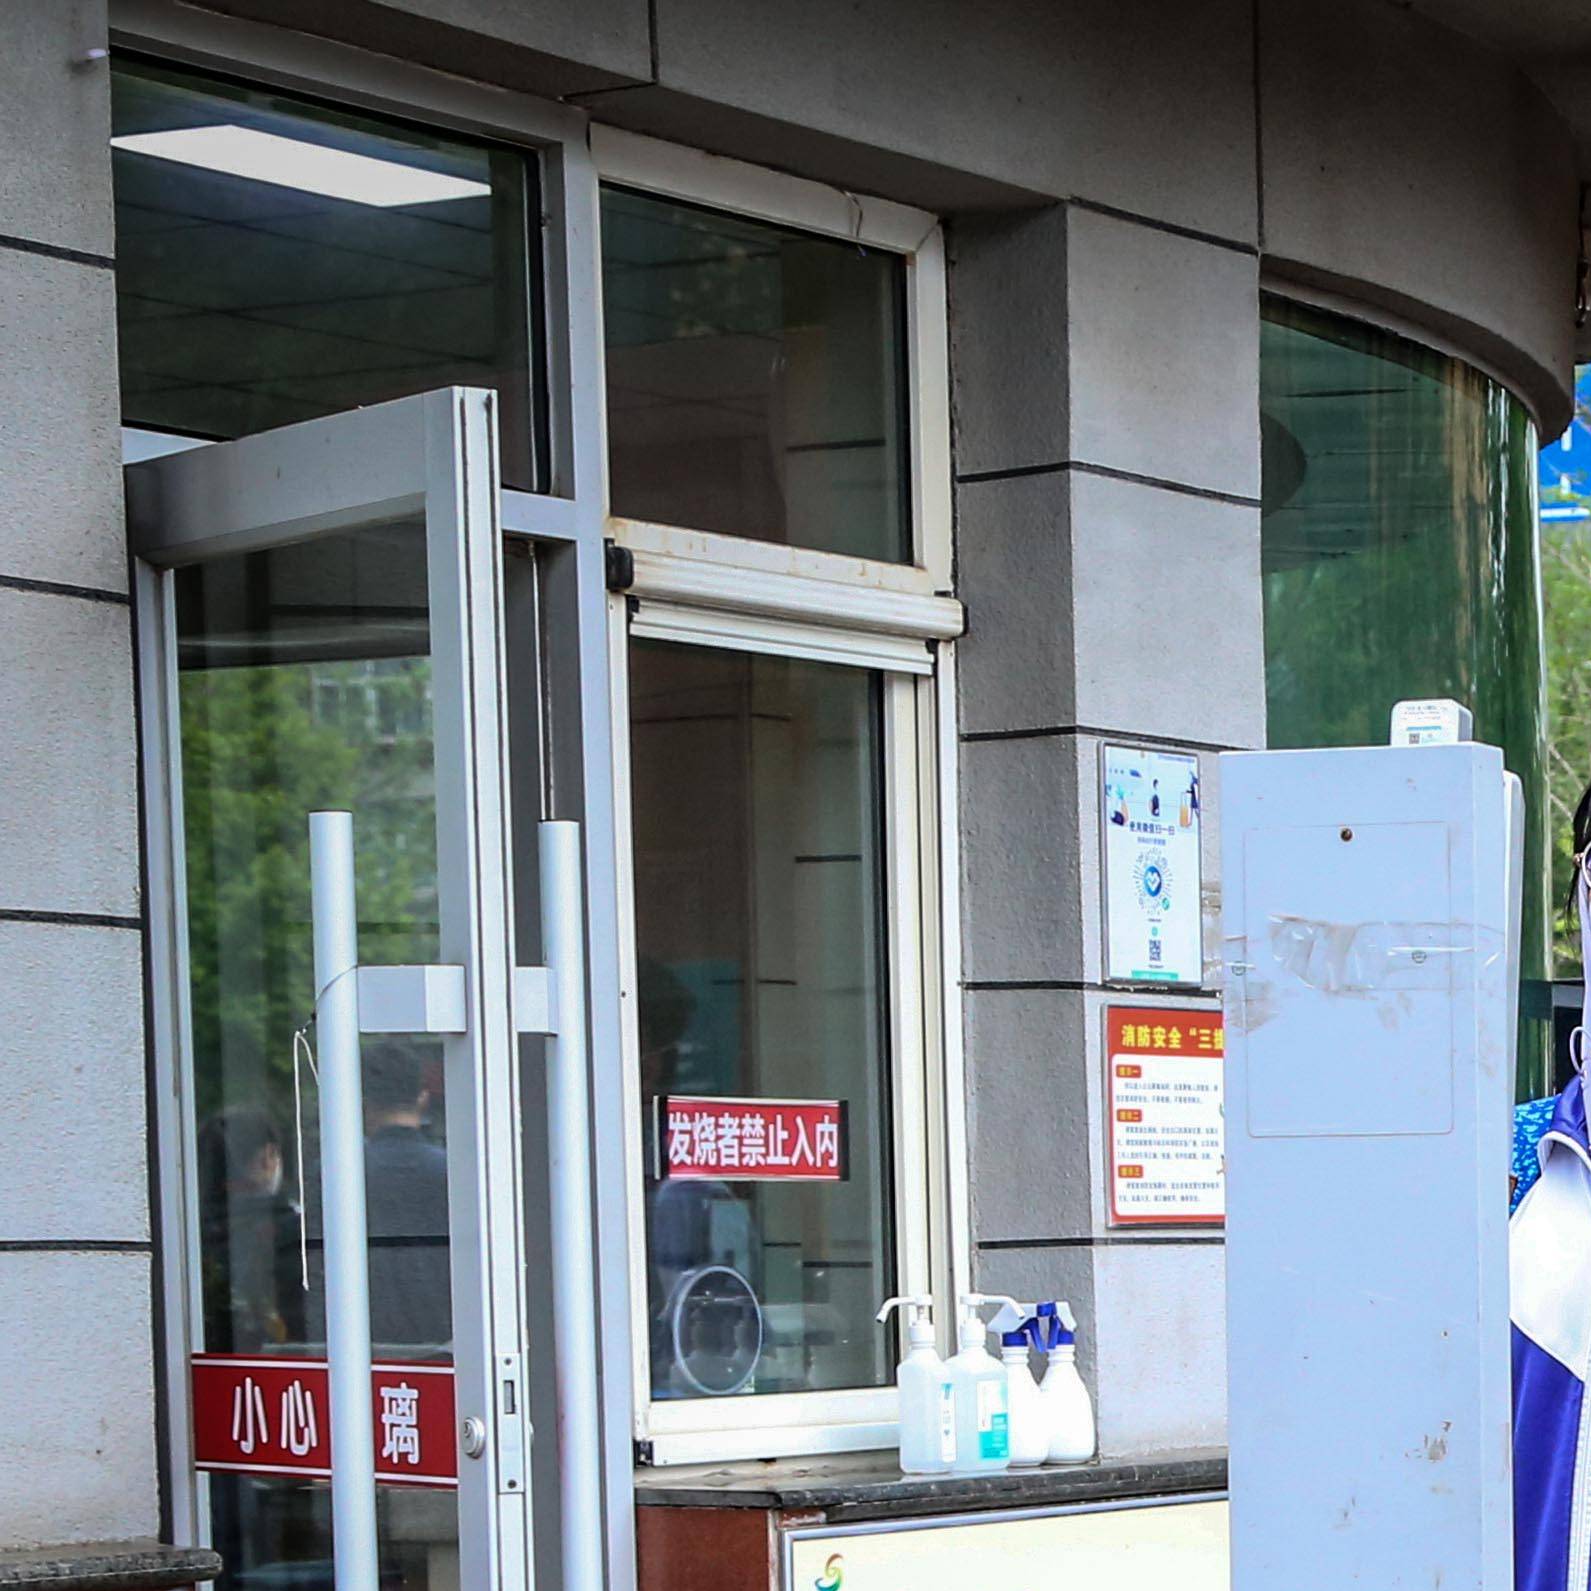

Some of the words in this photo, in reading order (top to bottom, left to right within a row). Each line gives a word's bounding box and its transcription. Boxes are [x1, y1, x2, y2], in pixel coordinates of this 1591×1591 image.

[668, 1112, 838, 1167] 发烧者禁止入内
[232, 1376, 421, 1465] 小心璃
